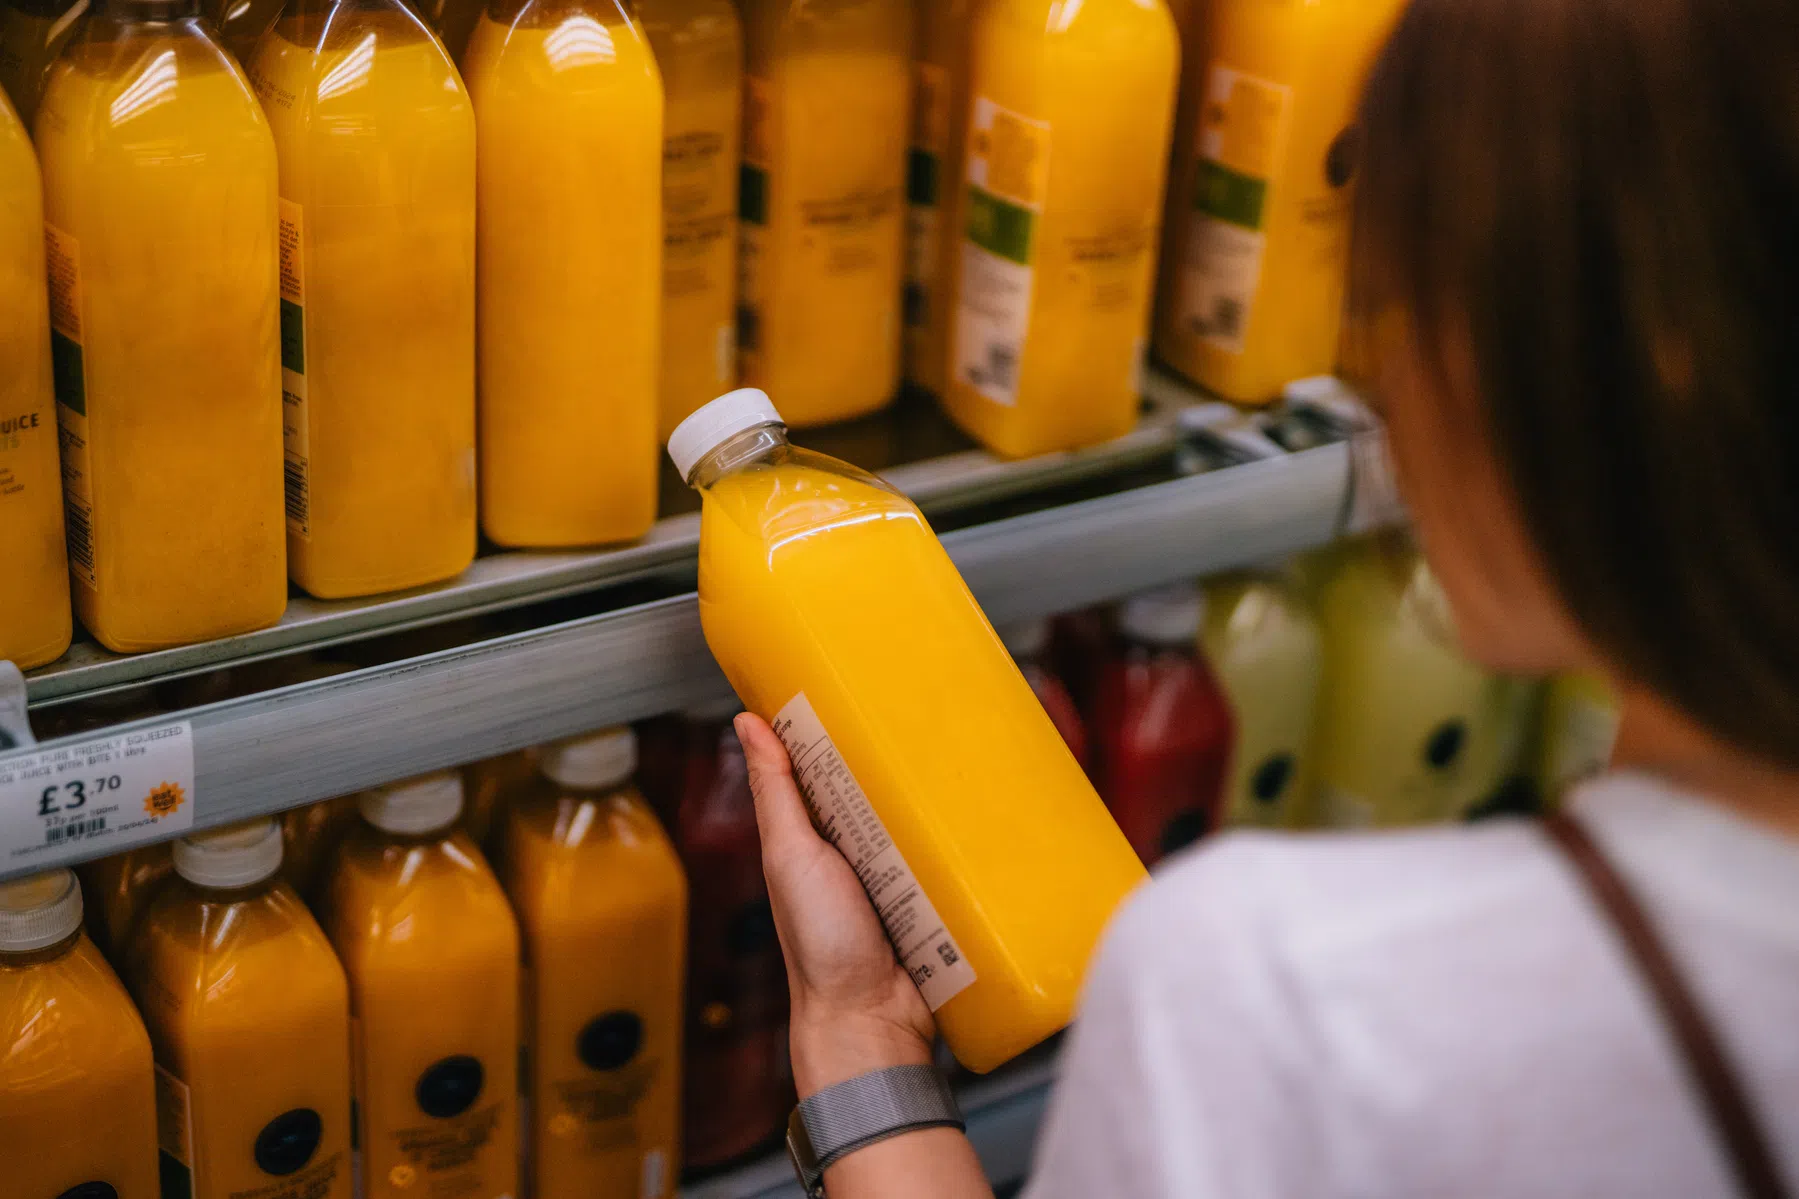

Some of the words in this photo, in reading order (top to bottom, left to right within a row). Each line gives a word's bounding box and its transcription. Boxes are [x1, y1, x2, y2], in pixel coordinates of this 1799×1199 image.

[1, 412, 40, 434] UICE
[74, 738, 122, 757] FRESHLY
[127, 726, 183, 746] SQUEEZED
[37, 775, 122, 815] £3.70
